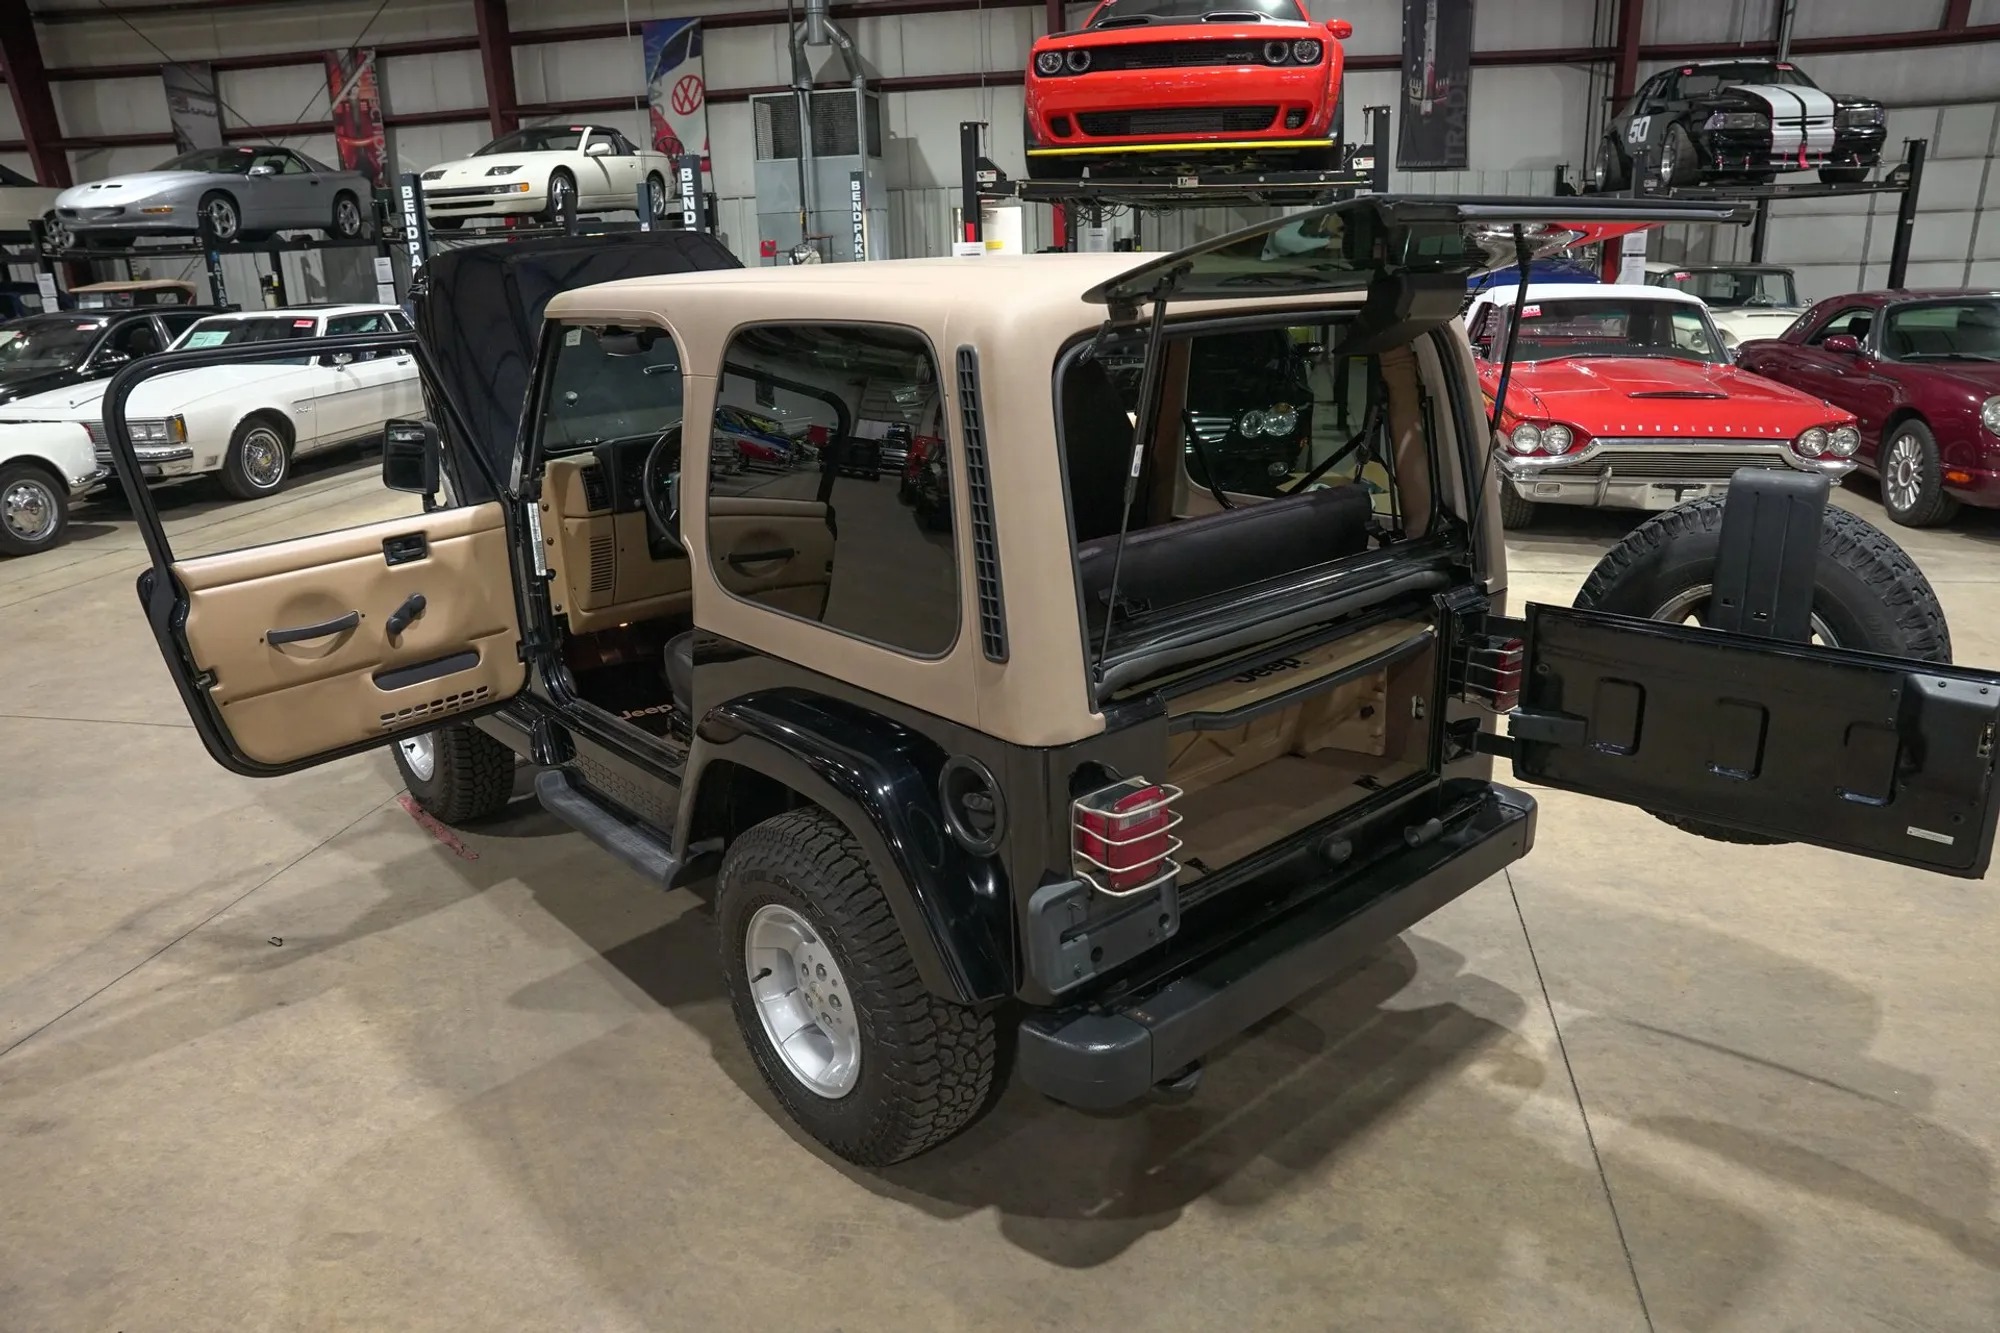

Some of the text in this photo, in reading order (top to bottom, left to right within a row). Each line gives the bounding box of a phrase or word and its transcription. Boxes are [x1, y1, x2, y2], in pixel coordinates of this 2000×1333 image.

[365, 48, 388, 165] PERFECTION
[1443, 70, 1468, 162] TRADE
[1628, 115, 1651, 144] 50
[680, 168, 697, 231] BEND
[851, 180, 864, 254] BENDPAK
[213, 262, 227, 307] ATLAS
[1232, 658, 1302, 683] Jeep
[620, 704, 673, 720] Jeep
